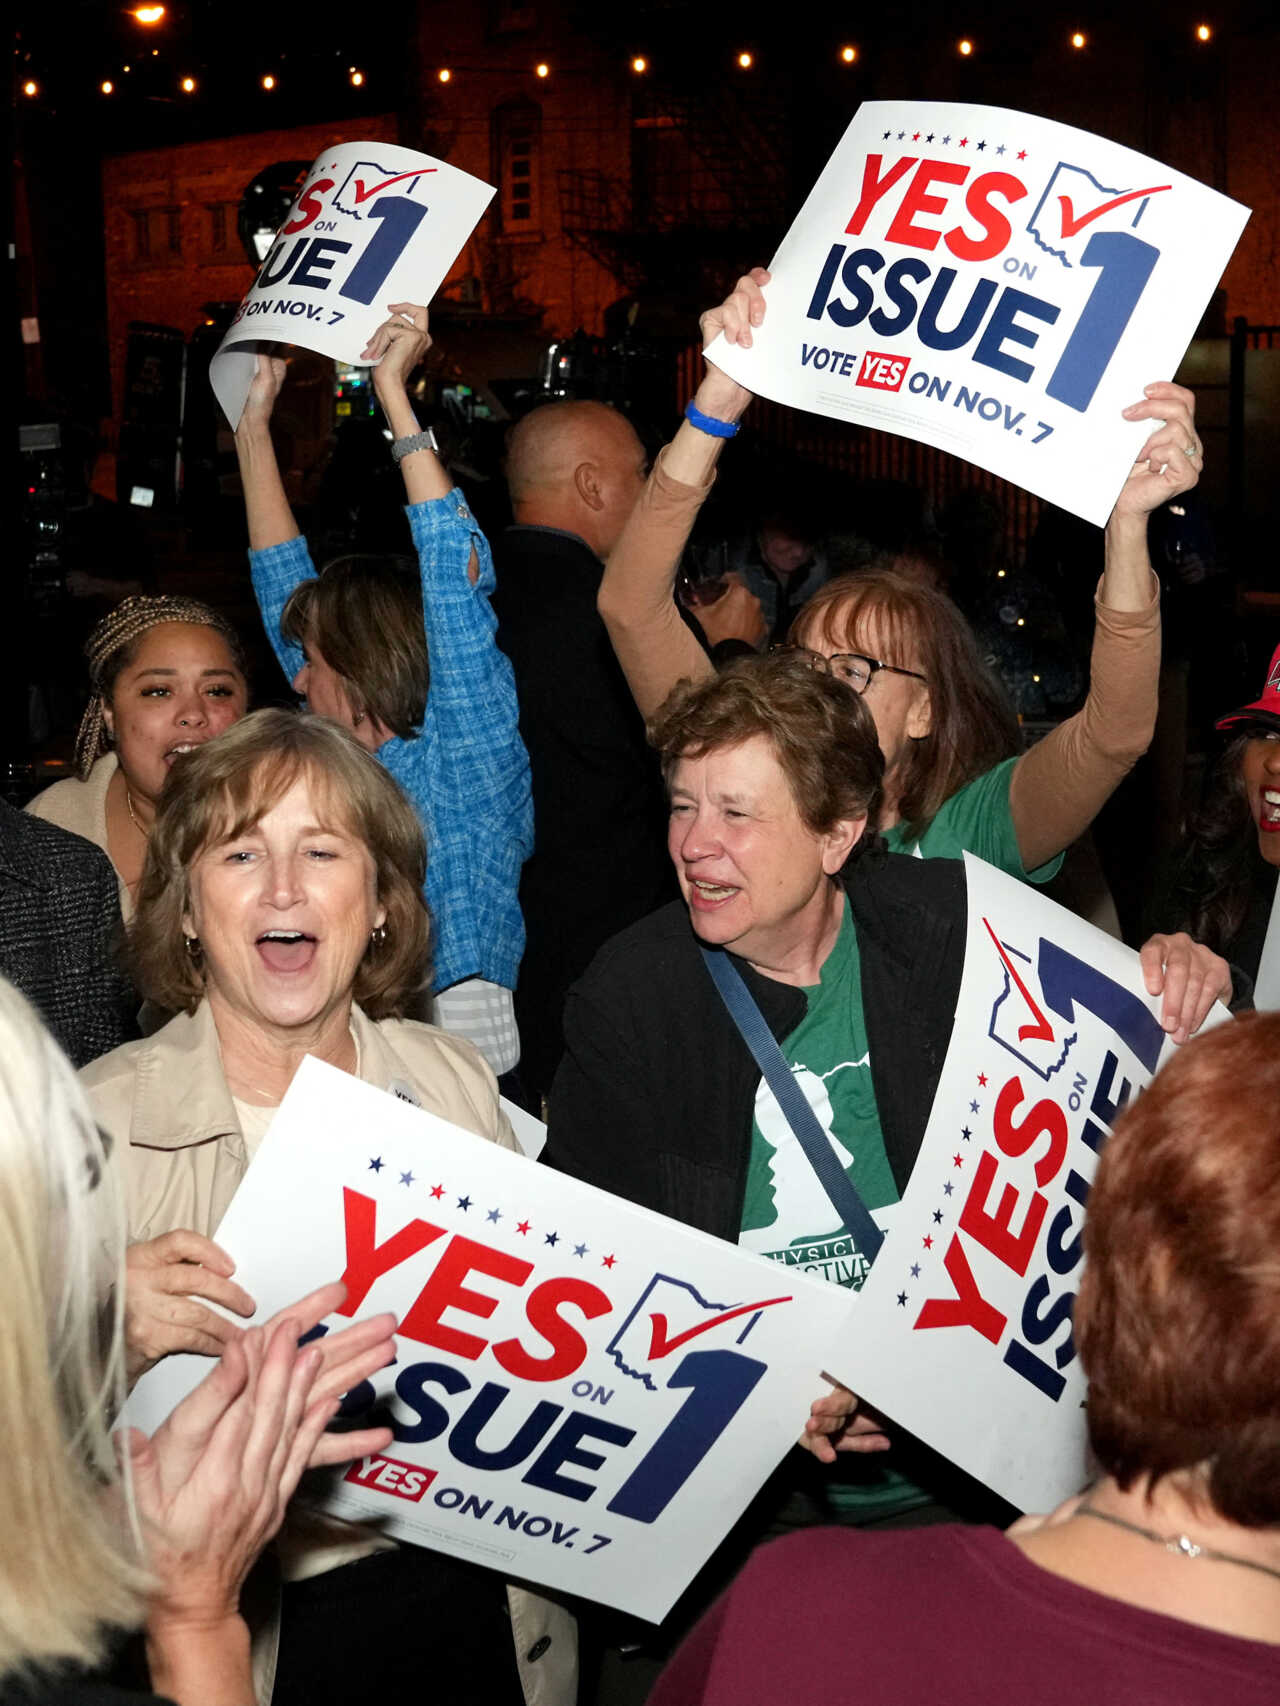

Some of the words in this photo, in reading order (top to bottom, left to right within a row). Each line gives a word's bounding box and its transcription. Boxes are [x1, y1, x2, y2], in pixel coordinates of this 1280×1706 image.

[314, 220, 337, 232] ON
[339, 195, 428, 306] 1
[844, 154, 1027, 262] YES
[1003, 258, 1037, 281] ON
[246, 300, 273, 316] ON
[273, 300, 323, 321] NOV.
[327, 311, 345, 325] 7
[807, 244, 1061, 383] ISSUE
[1045, 231, 1160, 413] 1
[800, 343, 857, 377] VOTE
[859, 355, 905, 386] YES
[908, 371, 952, 402] ON
[953, 385, 1027, 436] NOV.
[1031, 420, 1055, 444] 7
[1038, 936, 1165, 1074] 1
[913, 1076, 1068, 1345] YES
[1068, 1072, 1088, 1111] ON
[333, 1185, 613, 1382] YES
[571, 1379, 616, 1407] ON
[605, 1348, 768, 1524] 1
[357, 1455, 427, 1496] YES
[433, 1487, 494, 1520] ON
[493, 1505, 581, 1549] NOV.
[583, 1533, 612, 1555] 7
